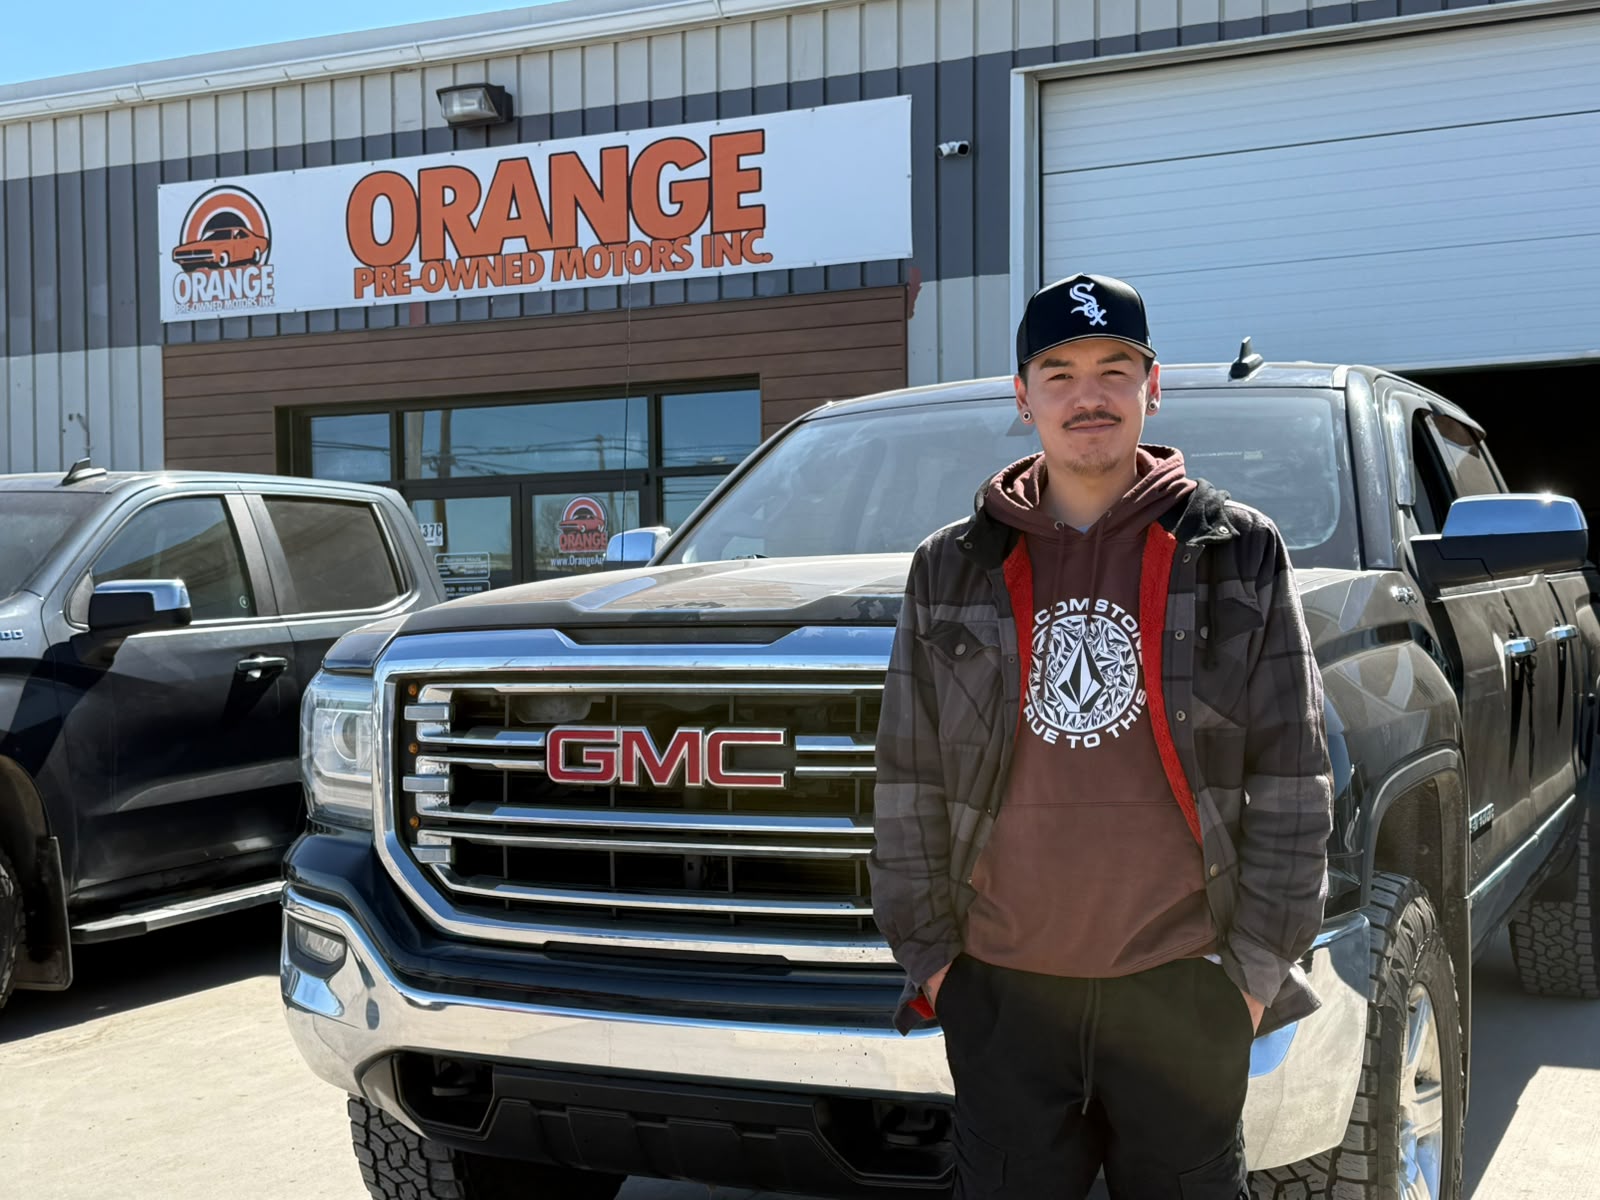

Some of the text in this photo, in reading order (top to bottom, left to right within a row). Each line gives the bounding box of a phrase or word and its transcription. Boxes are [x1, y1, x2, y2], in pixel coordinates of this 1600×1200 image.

[346, 129, 766, 268] ORANGE
[173, 264, 275, 305] ORANGE
[353, 229, 774, 299] PRE-OWNED MOTORS INC.
[224, 297, 258, 309] MOTORS
[1069, 283, 1107, 326] Sox
[418, 524, 442, 538] 37C
[559, 531, 608, 547] ORANGE
[1066, 733, 1101, 749] TO
[1105, 688, 1147, 739] THIS
[546, 725, 787, 789] GMC
